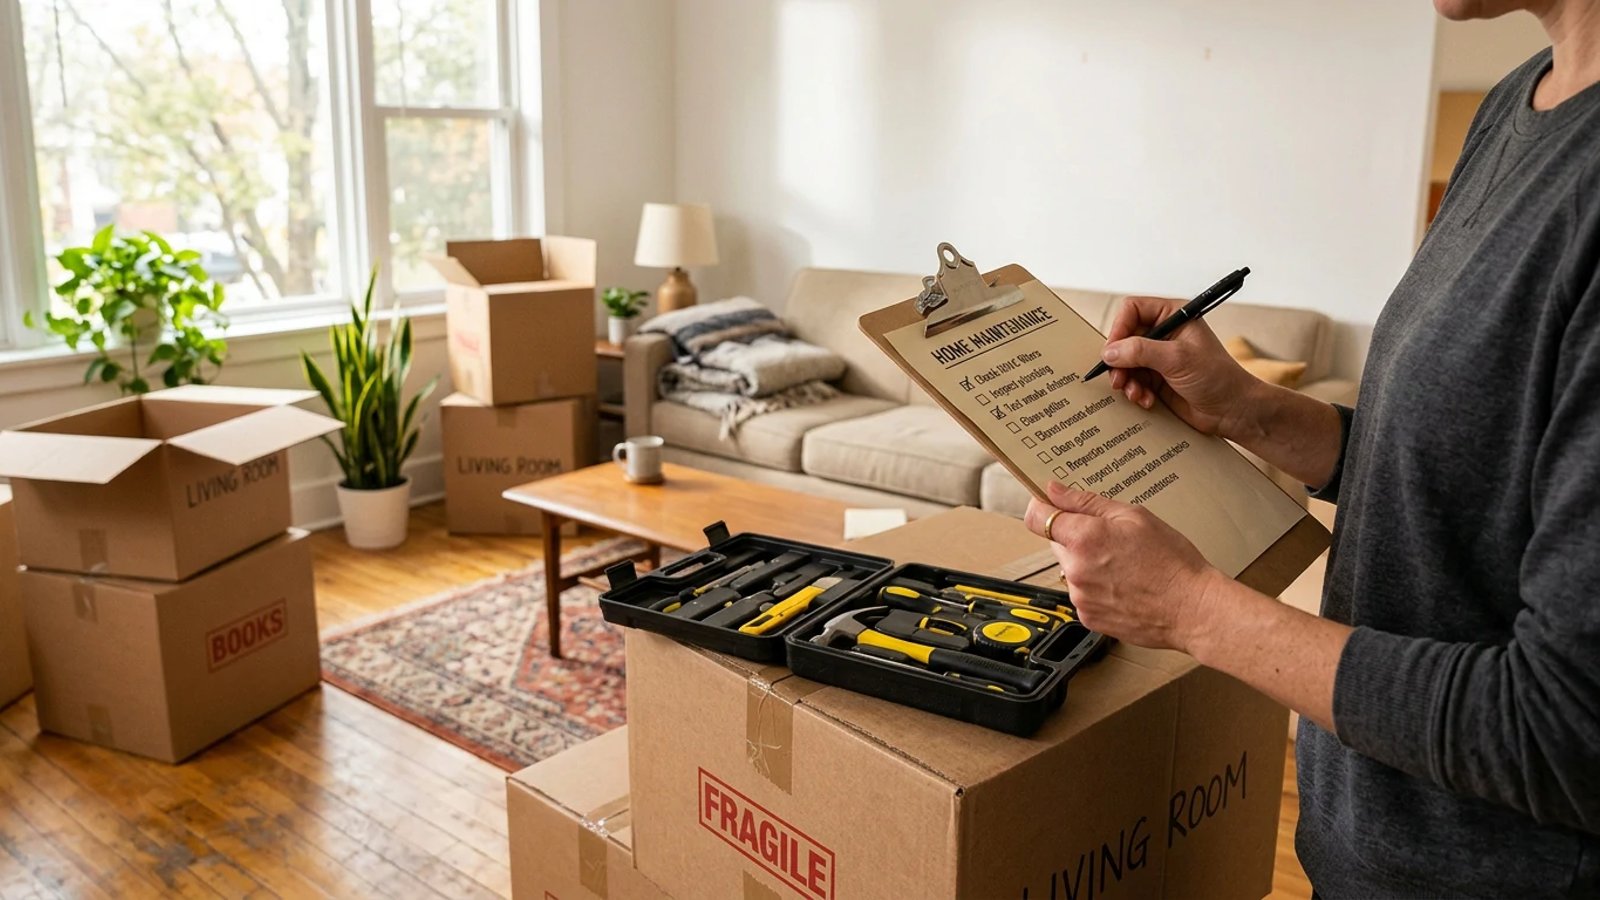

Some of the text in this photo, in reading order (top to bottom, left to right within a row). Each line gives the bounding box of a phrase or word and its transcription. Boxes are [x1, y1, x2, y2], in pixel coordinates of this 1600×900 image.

[931, 339, 974, 364] HOME
[186, 455, 279, 508] LIVING ROOM
[457, 456, 562, 474] LIVING ROOM
[211, 608, 284, 663] BOOKS
[704, 781, 827, 899] FRAGILE
[1022, 751, 1247, 900] IVING ROOM
